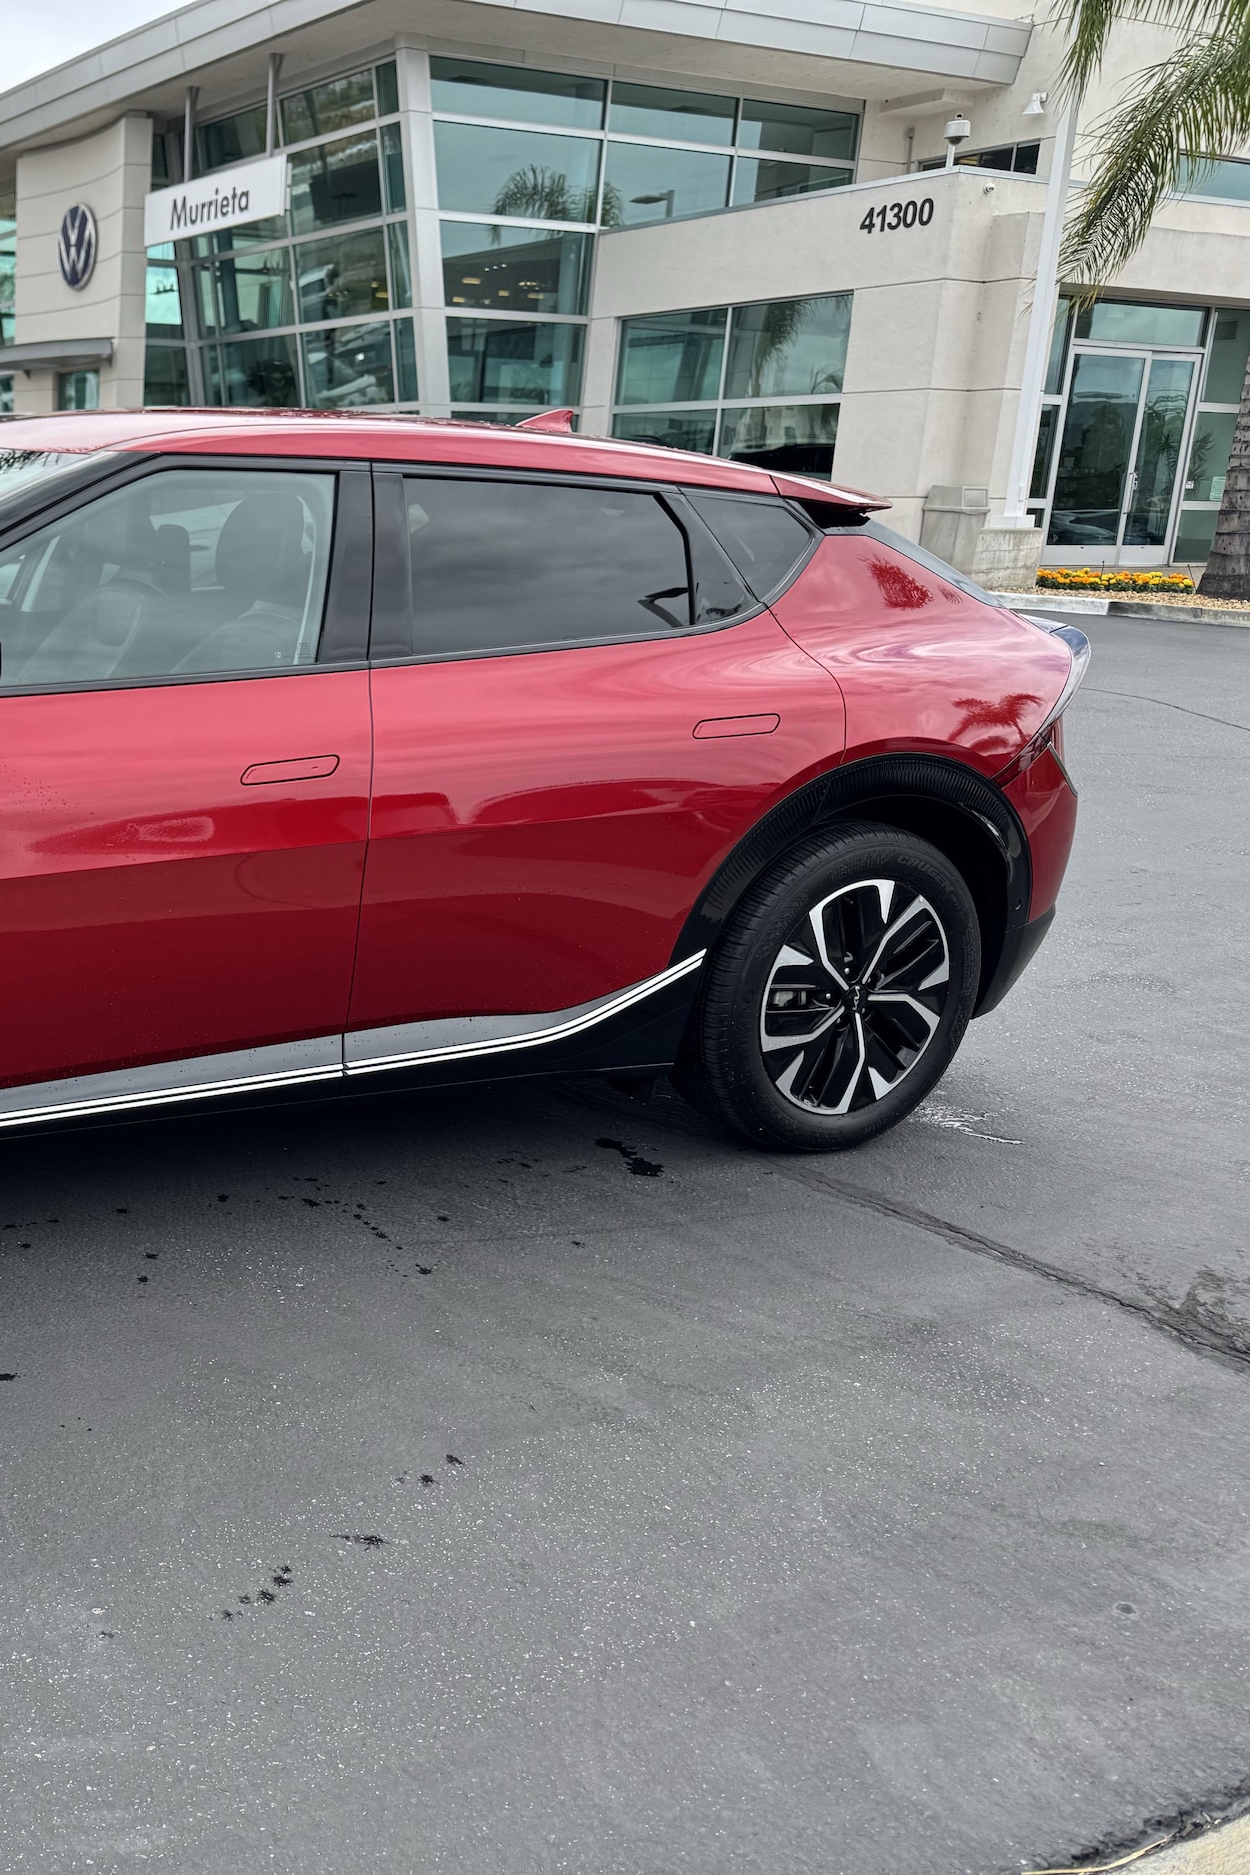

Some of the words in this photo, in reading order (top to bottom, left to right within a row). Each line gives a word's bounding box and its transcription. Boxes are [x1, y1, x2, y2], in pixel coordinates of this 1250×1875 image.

[170, 186, 250, 231] Murrieta
[859, 198, 934, 234] 41300
[58, 202, 98, 291] VW
[897, 854, 954, 895] CRUGEN
